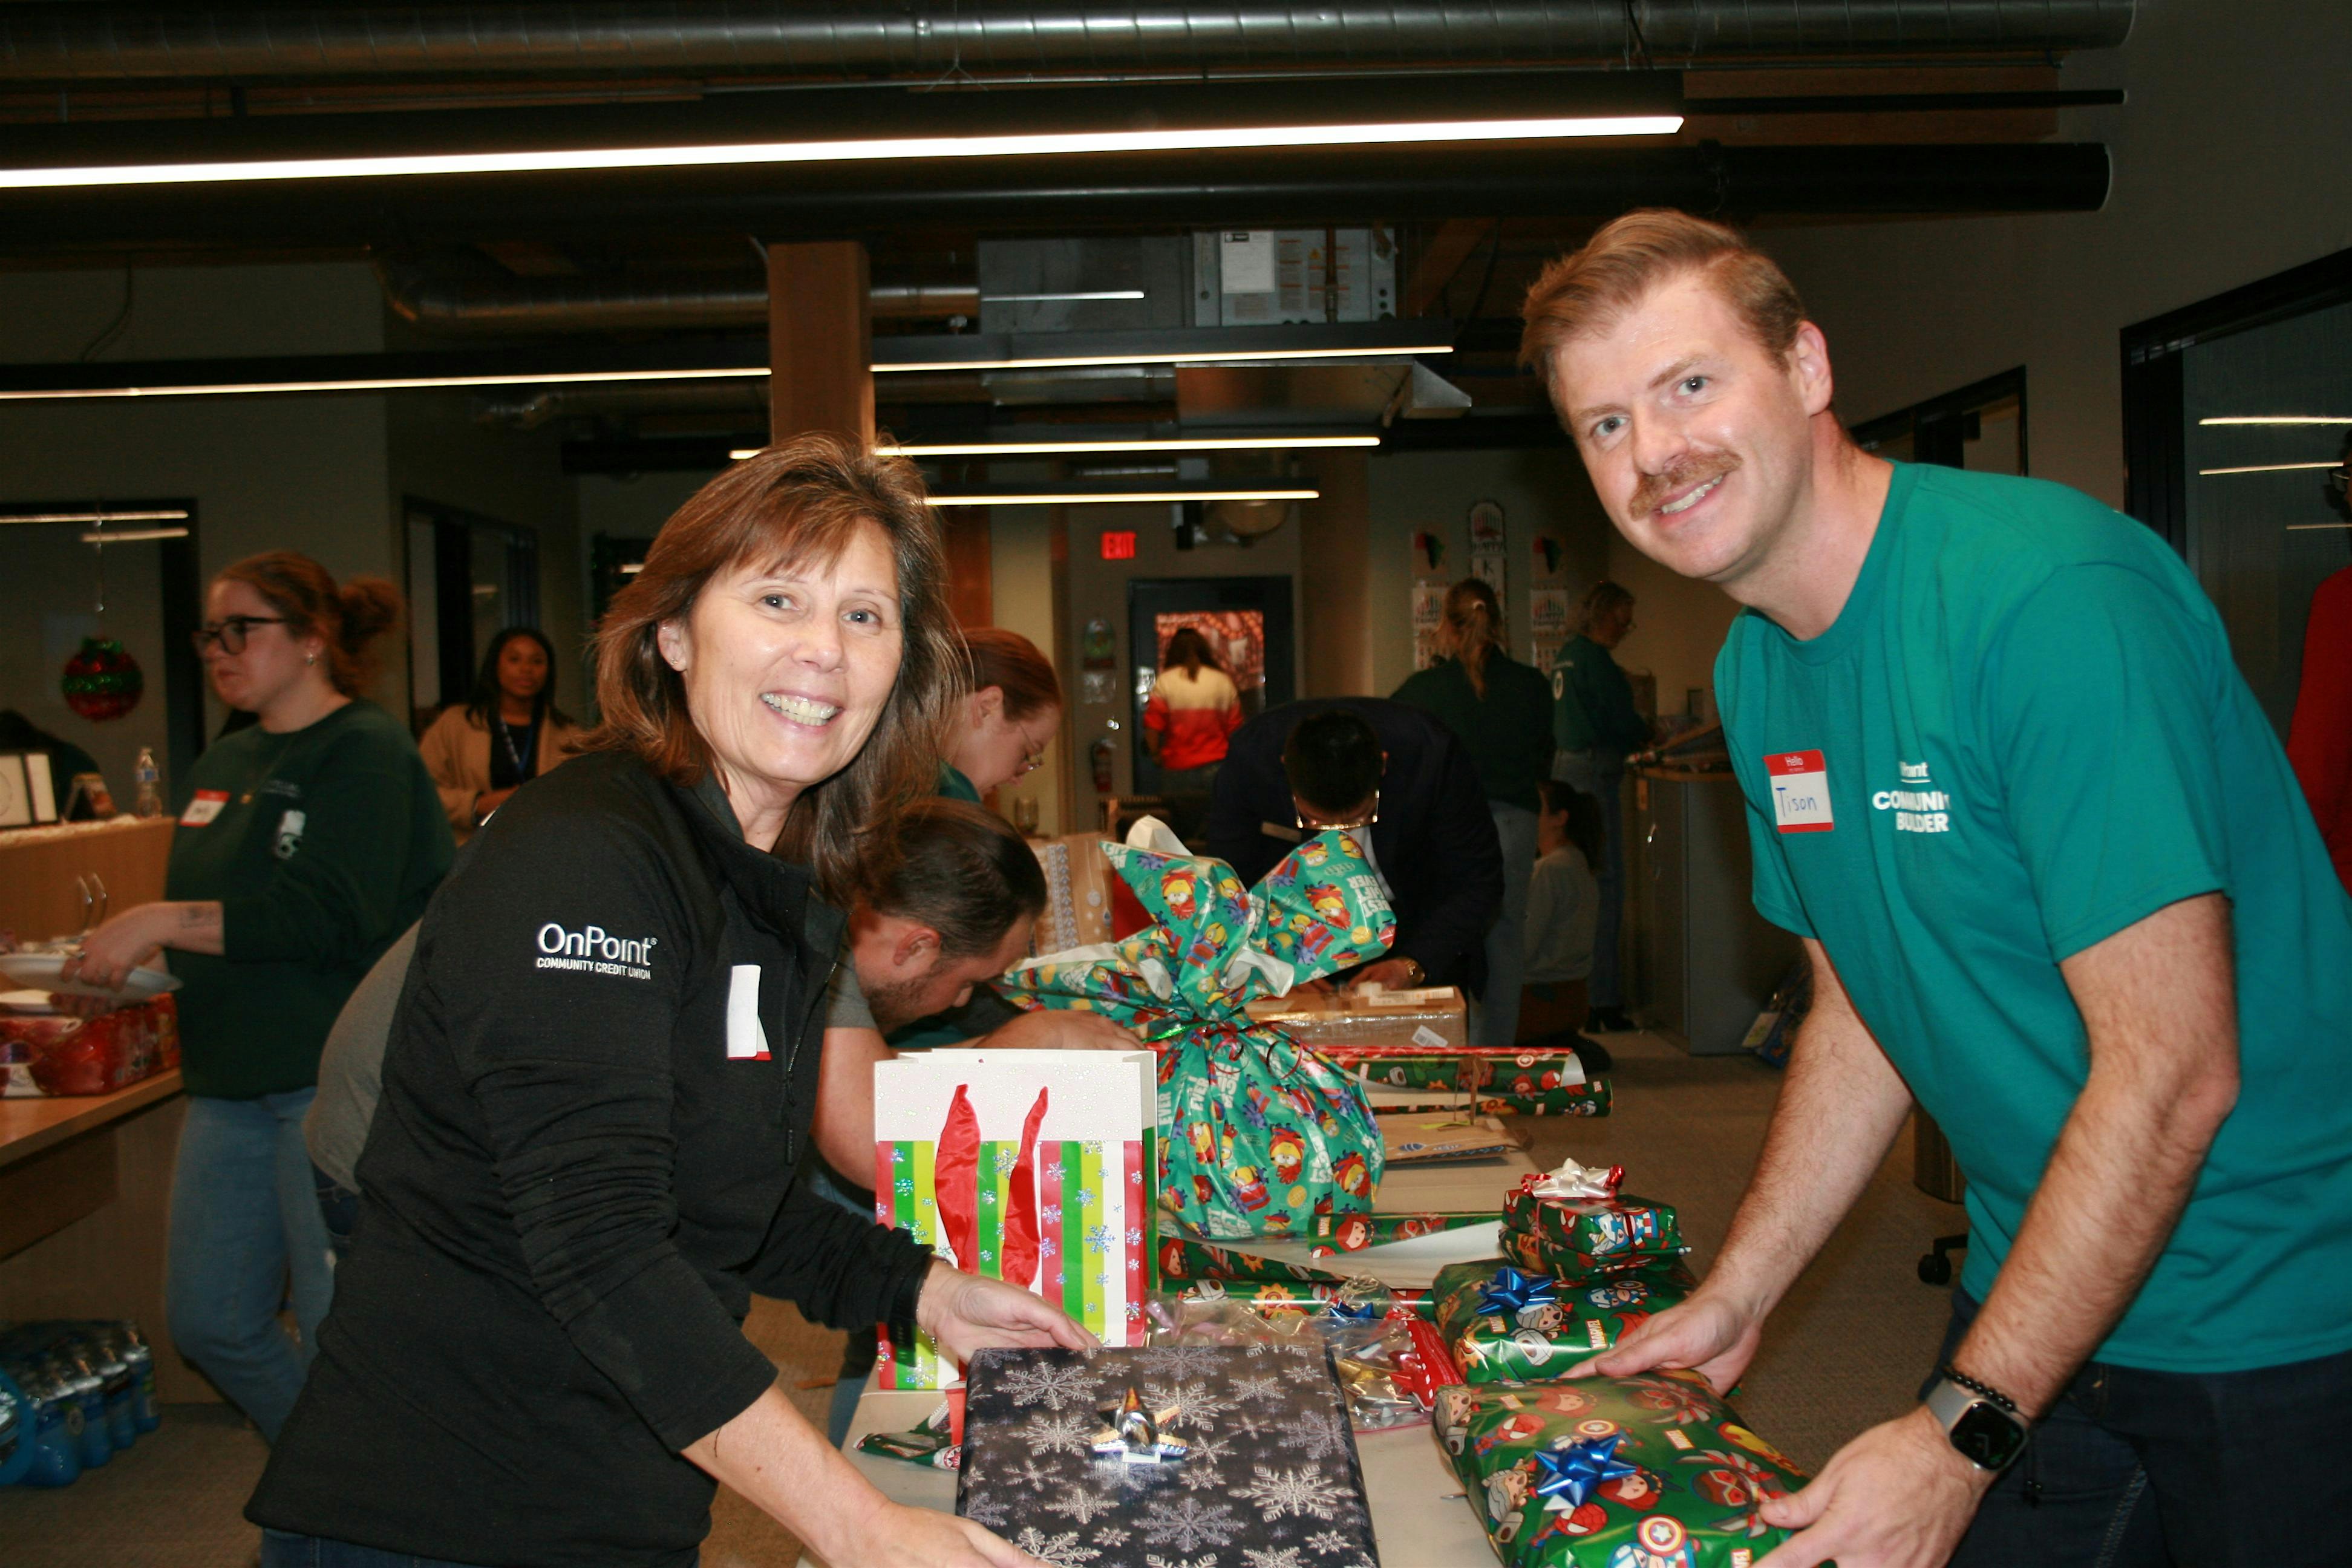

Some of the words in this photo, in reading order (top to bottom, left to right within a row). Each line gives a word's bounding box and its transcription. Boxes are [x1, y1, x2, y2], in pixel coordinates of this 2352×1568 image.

[1102, 532, 1136, 560] EXIT
[1775, 787, 1817, 817] Tison
[537, 956, 595, 972] COMMUNITY
[595, 963, 627, 976] CREDIT
[628, 967, 652, 981] UNION
[1158, 1091, 1172, 1126] EVER
[1586, 1319, 1608, 1349] MARVEL
